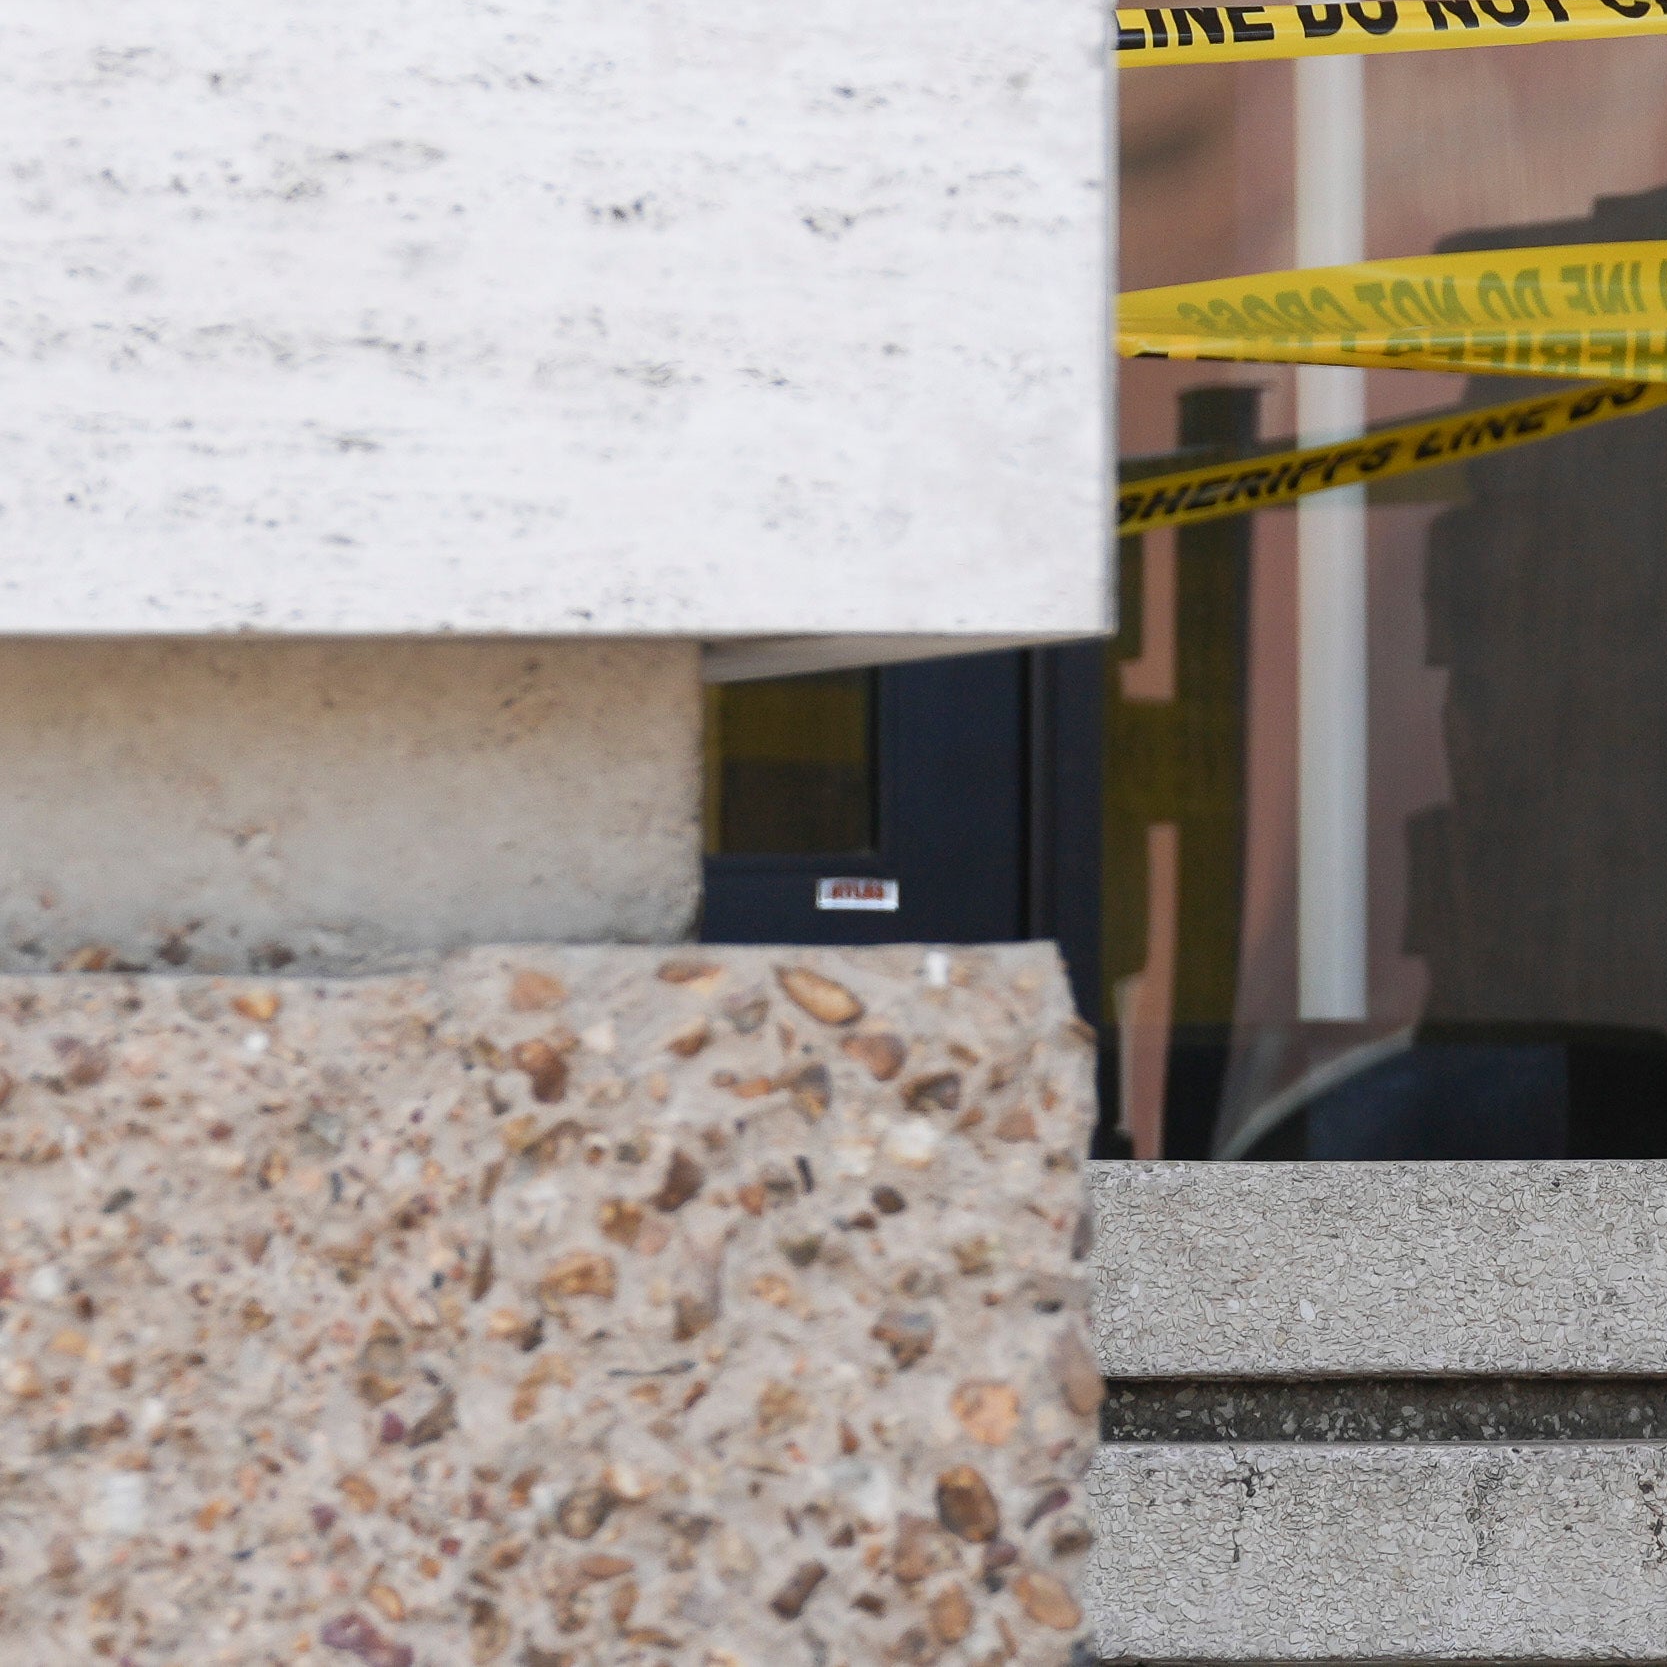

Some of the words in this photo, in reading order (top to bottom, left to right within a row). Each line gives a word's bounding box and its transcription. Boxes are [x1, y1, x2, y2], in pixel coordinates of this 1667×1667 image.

[1296, 0, 1399, 38] DO
[1118, 438, 1400, 525] SHERIFFS
[1415, 399, 1560, 460] LINE
